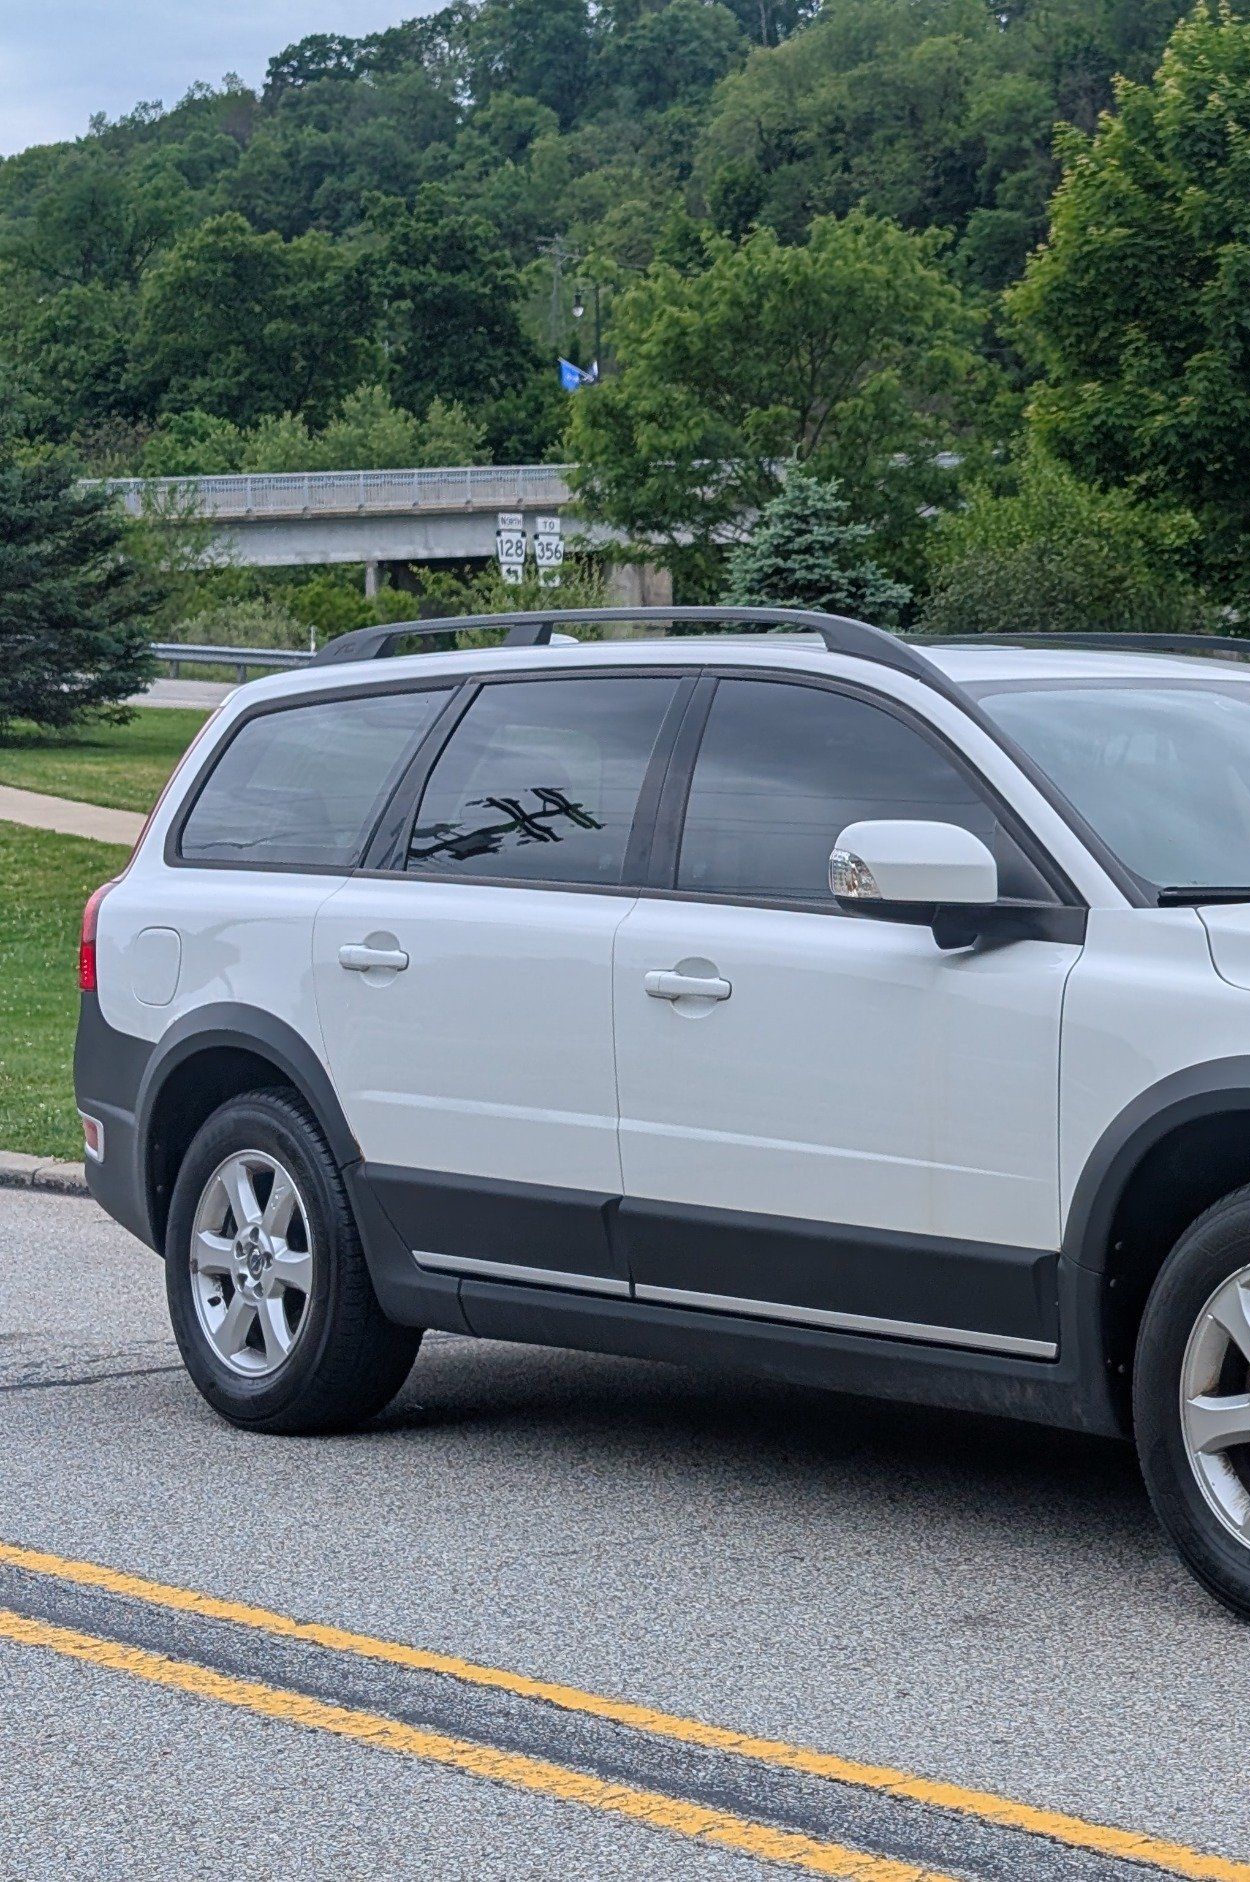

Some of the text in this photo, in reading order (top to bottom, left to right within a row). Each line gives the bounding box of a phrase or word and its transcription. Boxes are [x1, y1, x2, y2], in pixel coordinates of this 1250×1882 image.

[543, 520, 555, 530] TO
[499, 538, 524, 558] 128
[537, 541, 563, 560] 356
